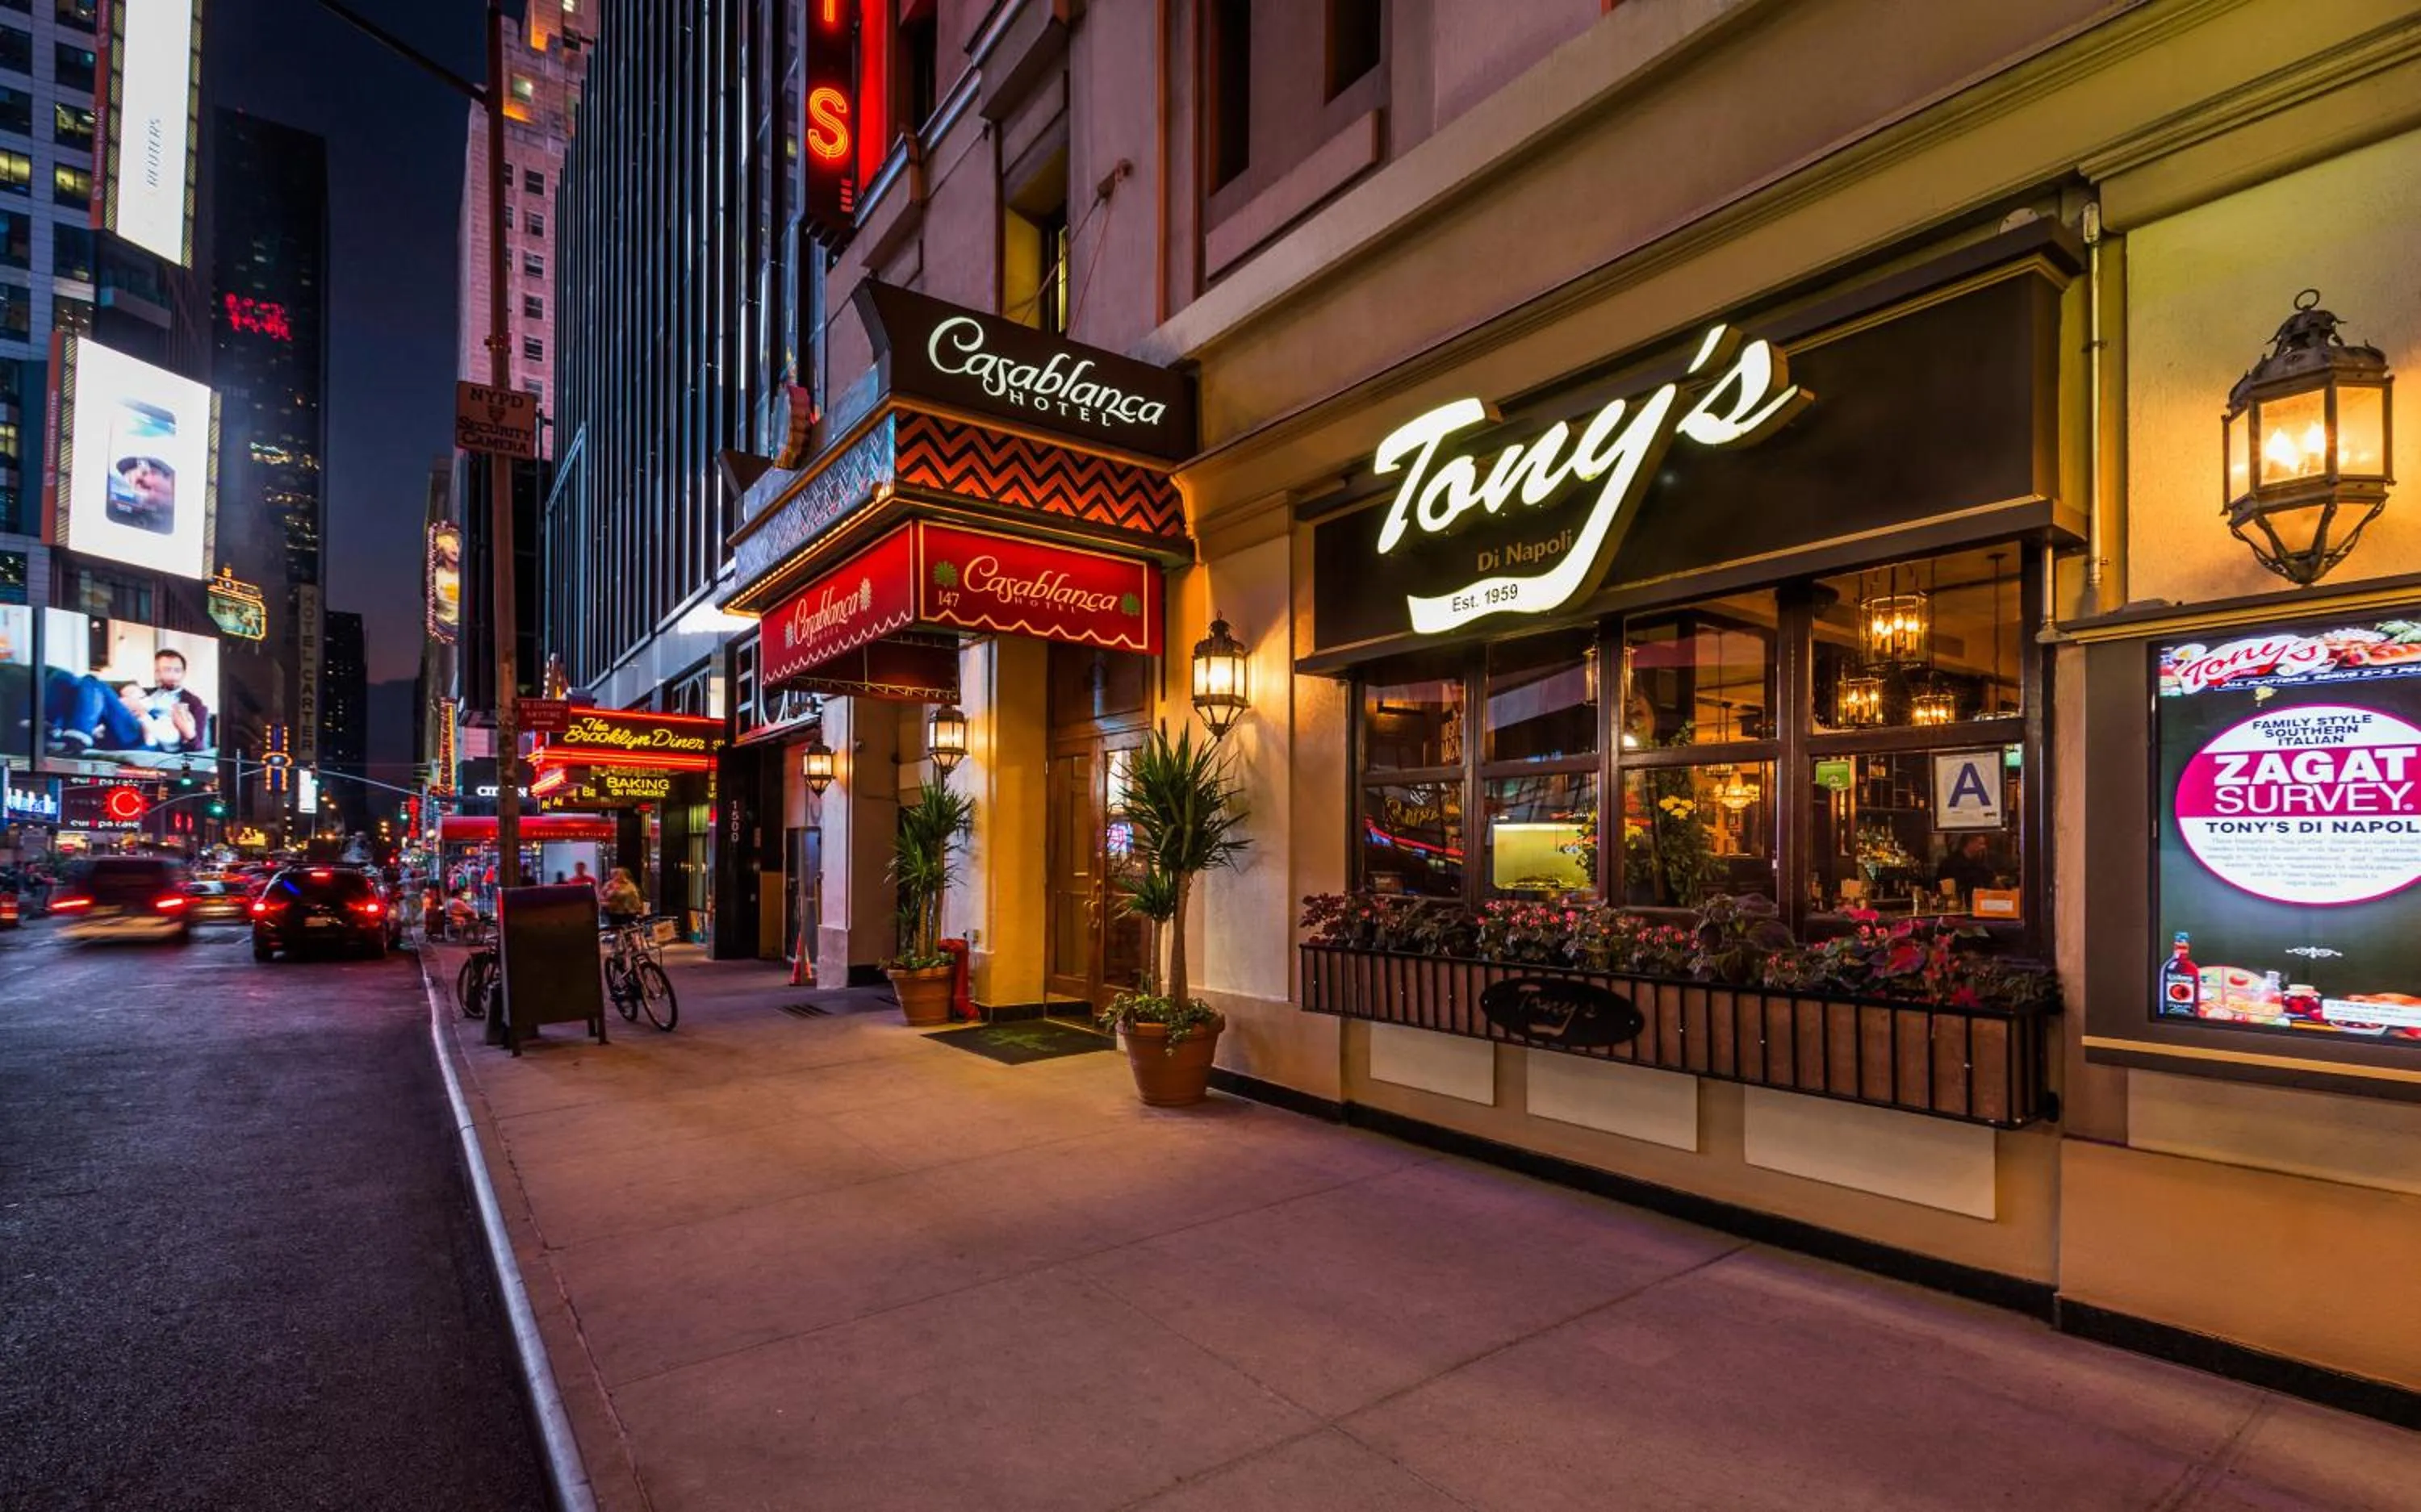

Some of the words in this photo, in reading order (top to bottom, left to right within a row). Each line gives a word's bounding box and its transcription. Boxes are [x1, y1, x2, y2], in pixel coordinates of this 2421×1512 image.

[928, 316, 1166, 425] Casablanca
[470, 387, 524, 407] NYPD
[1009, 387, 1111, 427] HOTEL
[457, 416, 531, 441] SECURITY
[461, 430, 528, 453] CAMERA
[1374, 324, 1799, 634] Tony's
[1477, 549, 1500, 572] Di
[1506, 528, 1573, 566] Napoli
[964, 555, 1118, 612] Casablanca
[939, 590, 960, 608] 147
[1014, 595, 1076, 613] HOTEL
[1452, 595, 1478, 612] Est.
[1485, 583, 1519, 604] 1959
[794, 585, 859, 647] Casablanca
[2181, 641, 2318, 686] Tony's
[302, 669, 314, 751] CARTER
[2252, 717, 2311, 729] FAMILY
[2317, 714, 2372, 725] STYLE
[582, 717, 611, 732] The
[2264, 725, 2359, 738] SOUTHERN
[563, 725, 651, 750] Brooklyn
[652, 729, 705, 750] Diner
[2277, 734, 2344, 746] ITALIAN
[2214, 747, 2417, 786] ZAGAT
[606, 776, 670, 791] BAKING
[611, 788, 625, 797] ON
[1947, 762, 1992, 808] A
[69, 818, 114, 829] europa
[2206, 821, 2290, 834] TONY'S
[2299, 821, 2323, 833] DI
